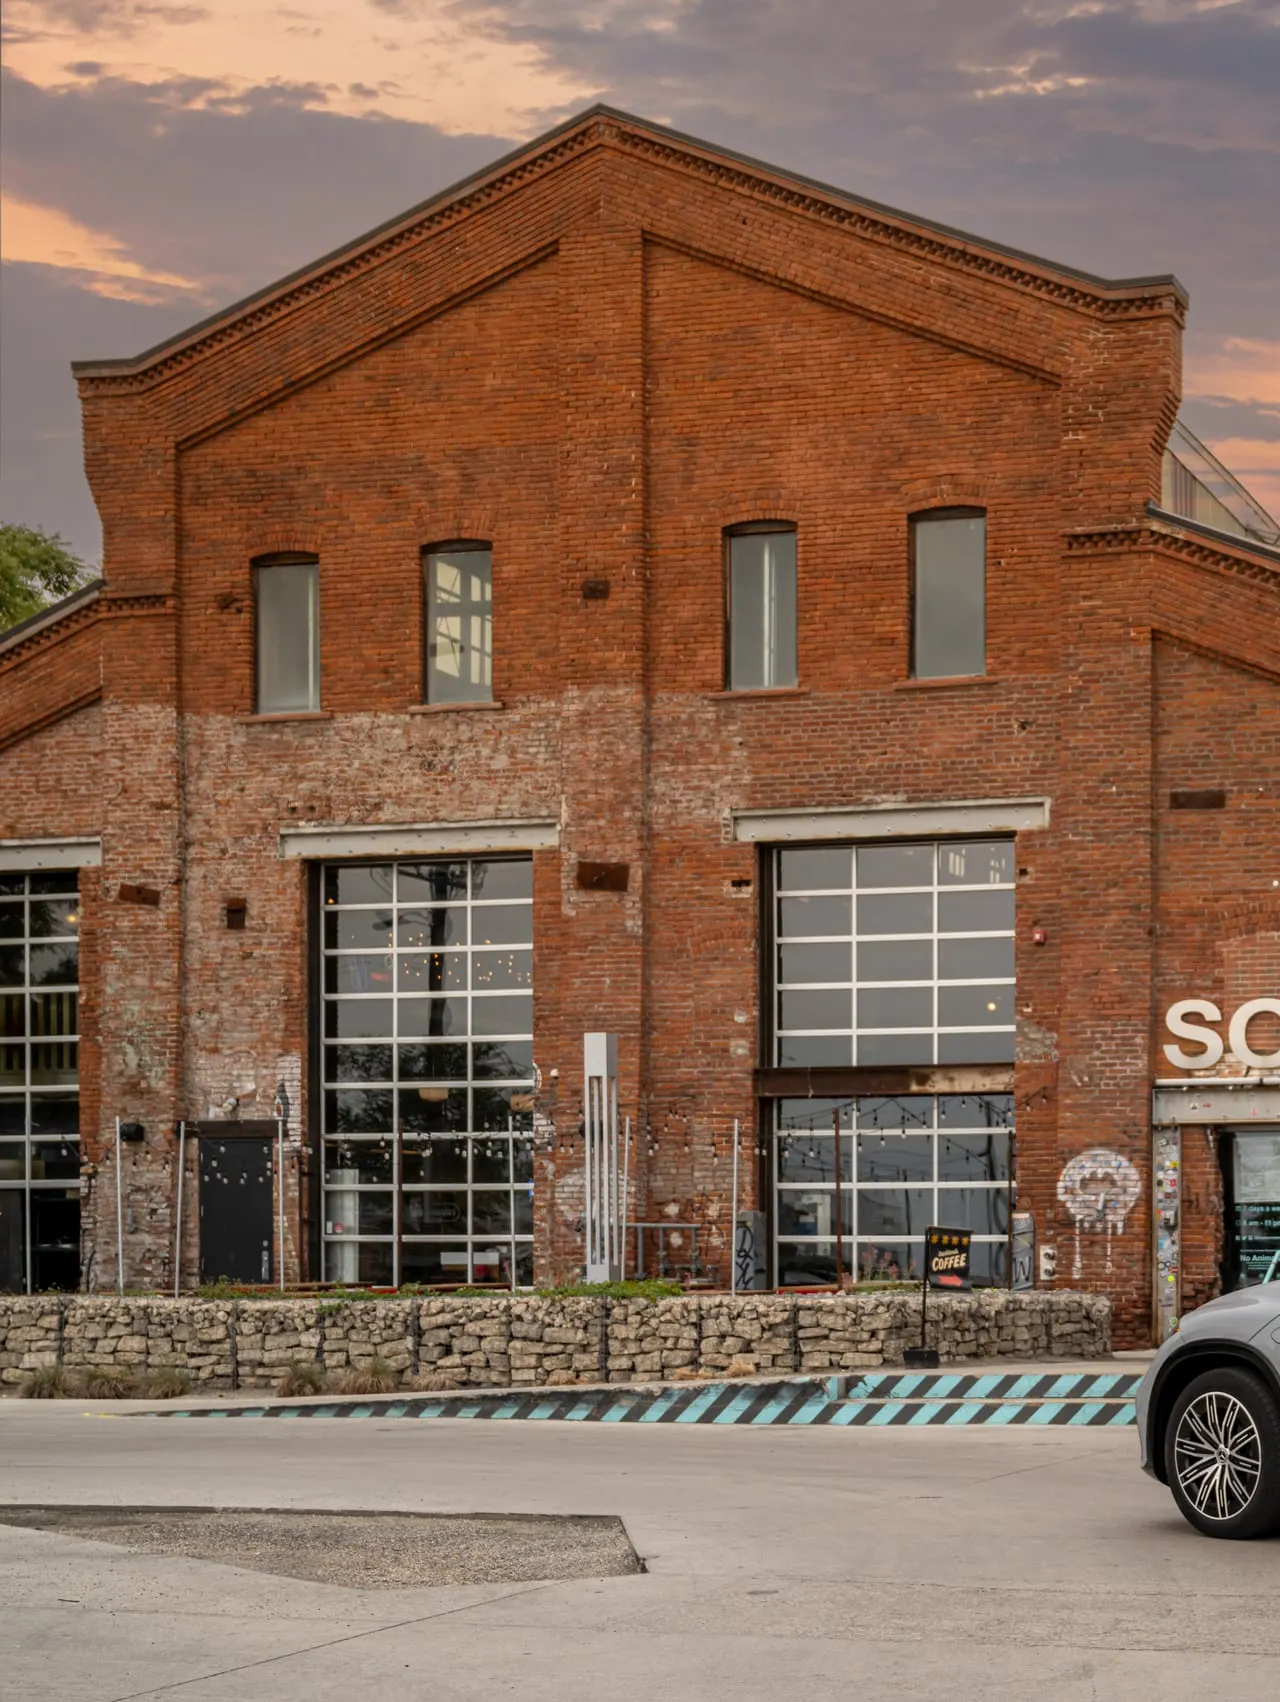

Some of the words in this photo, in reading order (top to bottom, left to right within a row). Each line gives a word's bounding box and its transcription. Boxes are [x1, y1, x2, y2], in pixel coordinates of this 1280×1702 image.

[1248, 1205, 1264, 1213] days
[1240, 1254, 1251, 1262] No
[932, 1253, 967, 1272] COFFEE
